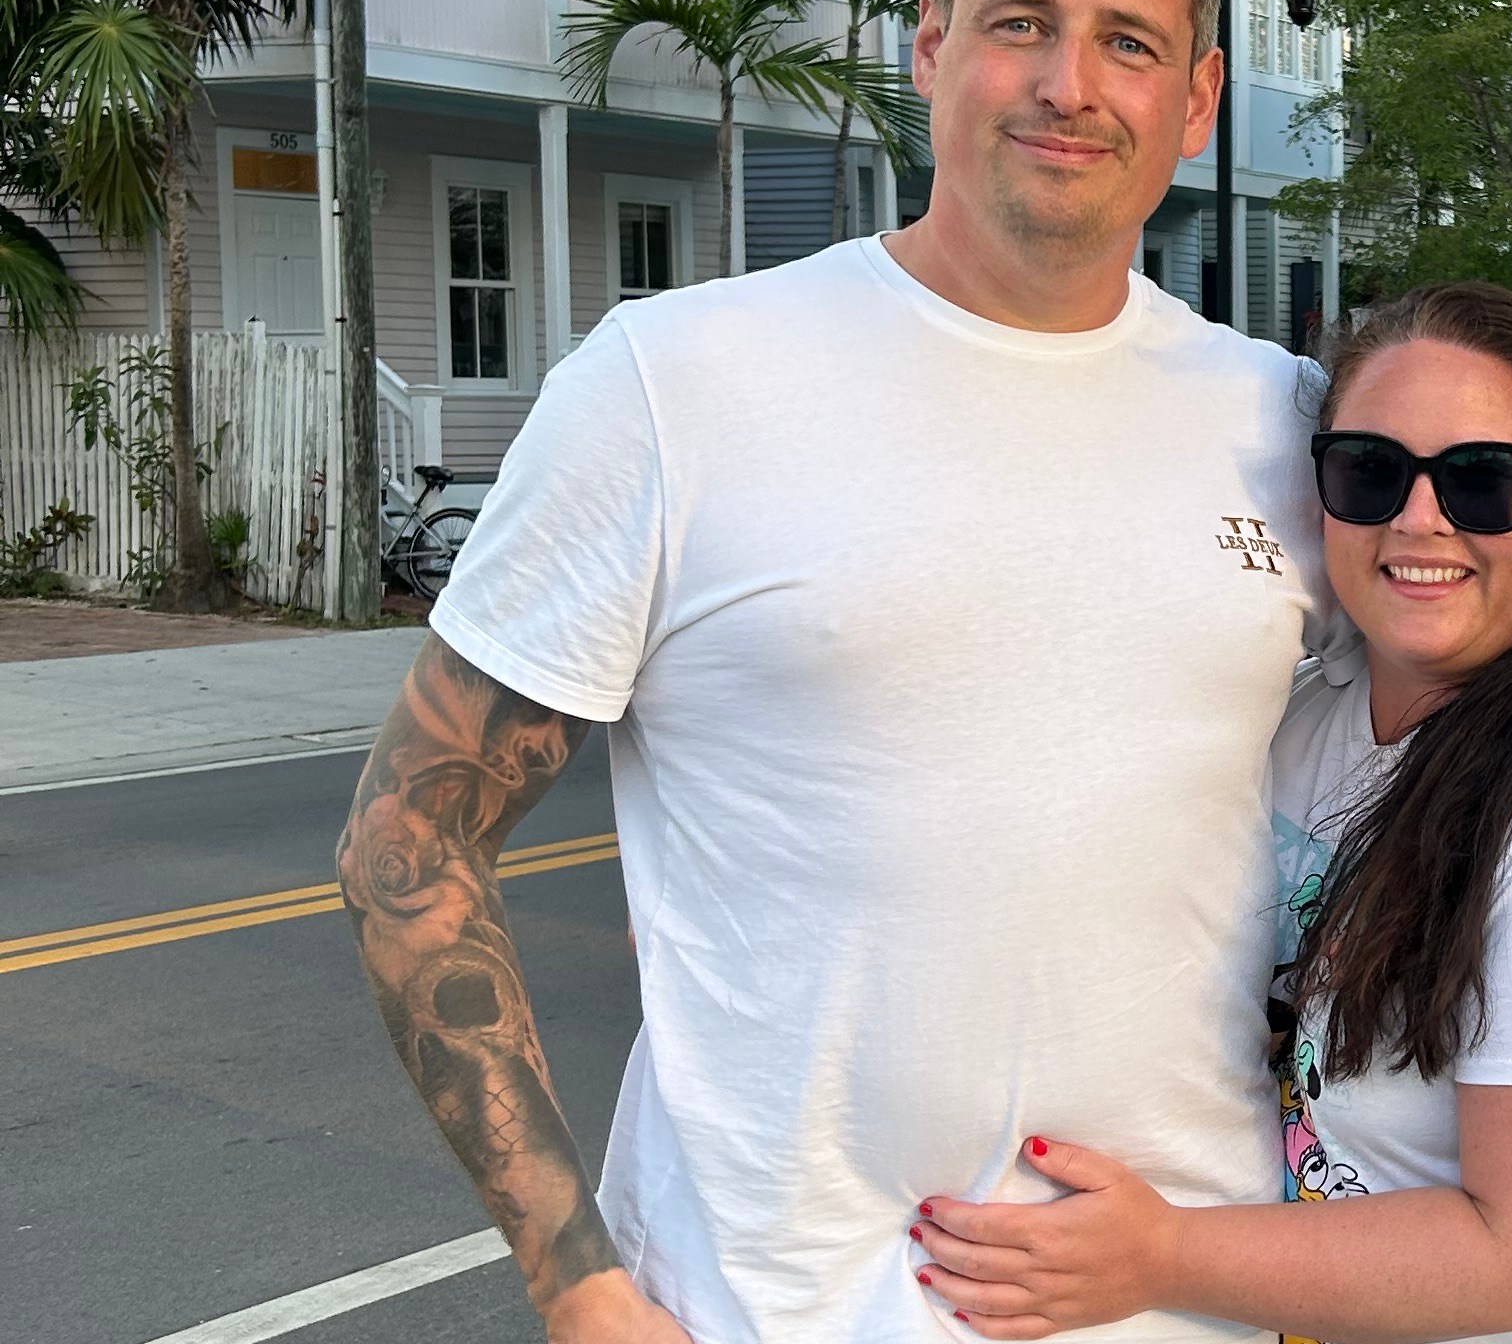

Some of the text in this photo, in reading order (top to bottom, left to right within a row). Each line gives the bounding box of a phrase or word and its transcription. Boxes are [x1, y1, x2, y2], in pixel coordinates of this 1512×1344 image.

[270, 131, 298, 150] 505
[1214, 534, 1284, 557] LES DEUX
